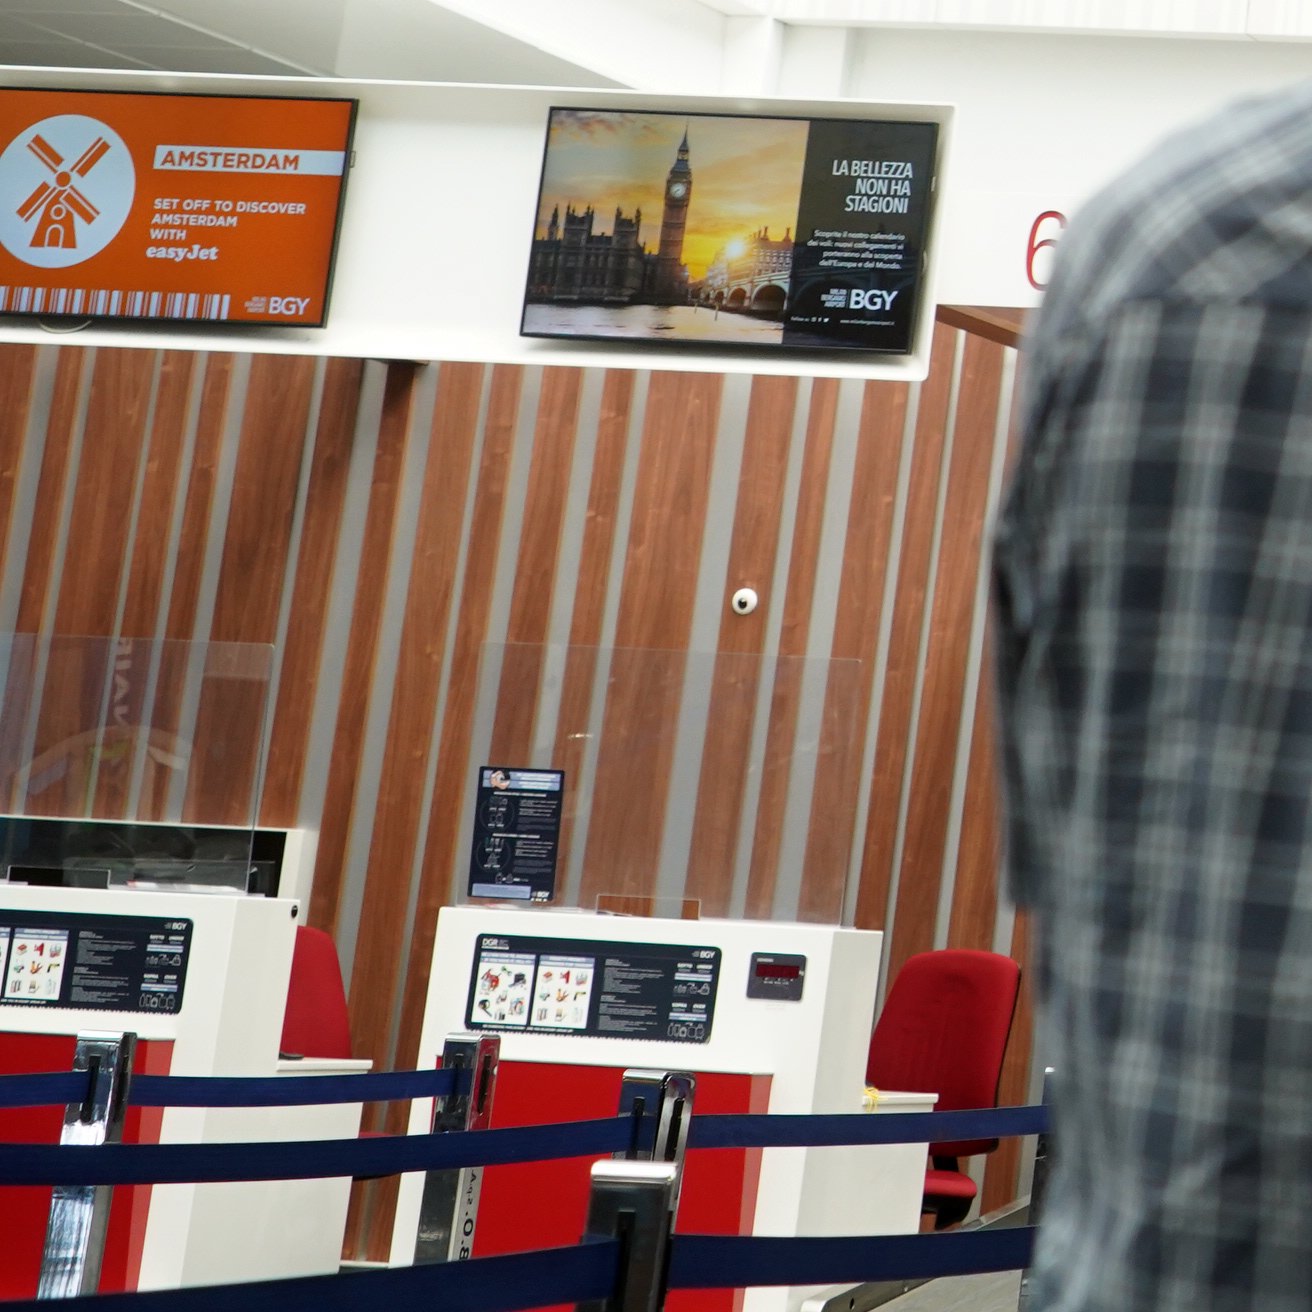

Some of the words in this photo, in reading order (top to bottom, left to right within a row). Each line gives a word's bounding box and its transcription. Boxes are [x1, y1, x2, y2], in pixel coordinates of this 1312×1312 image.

[161, 151, 299, 170] AMSTERDAM
[833, 160, 849, 176] LA
[850, 161, 912, 178] BELLEZZA
[856, 179, 889, 194] NON
[892, 180, 911, 196] HA
[154, 199, 179, 210] SET
[183, 200, 210, 211] OFF
[215, 201, 233, 212] TO
[237, 202, 305, 214] DISCOVER
[845, 196, 909, 213] STAGIONI
[152, 215, 237, 226] AMSTERDAM
[150, 229, 186, 239] WITH
[147, 245, 218, 262] easyJet
[269, 297, 310, 315] BGY
[850, 290, 897, 311] BGY
